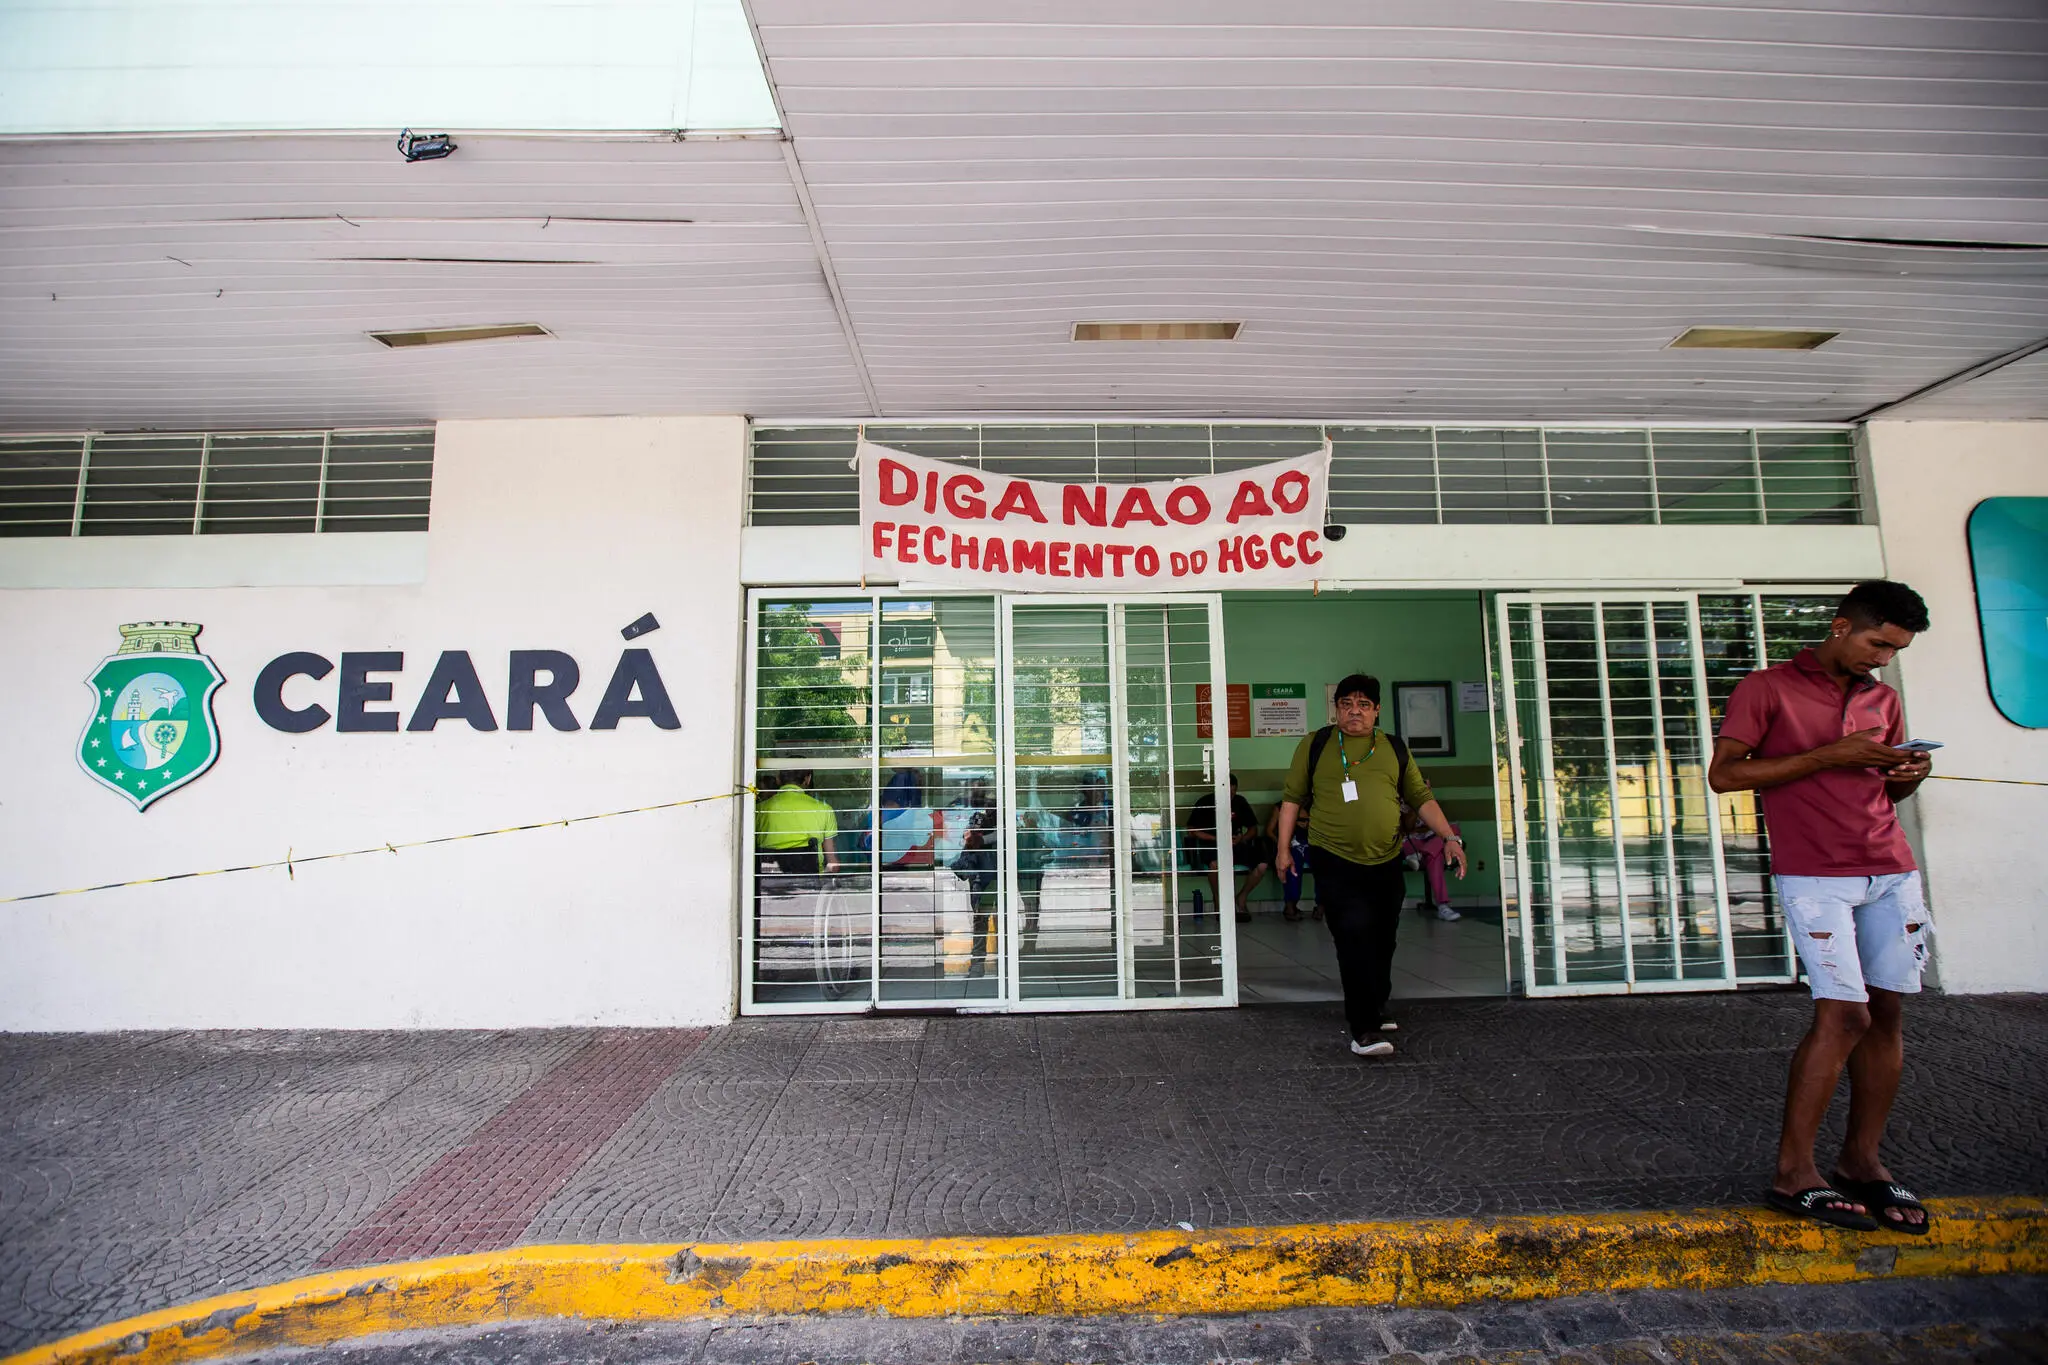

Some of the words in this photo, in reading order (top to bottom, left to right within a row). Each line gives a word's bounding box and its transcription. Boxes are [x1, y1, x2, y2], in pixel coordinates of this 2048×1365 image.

[879, 457, 1049, 523] DIGA
[1063, 485, 1212, 528] NAO
[1226, 470, 1310, 524] AO
[872, 521, 1160, 578] FECHAMENTO
[1169, 550, 1208, 577] DO
[1217, 530, 1323, 574] HGCC
[253, 612, 681, 734] CEARÁ
